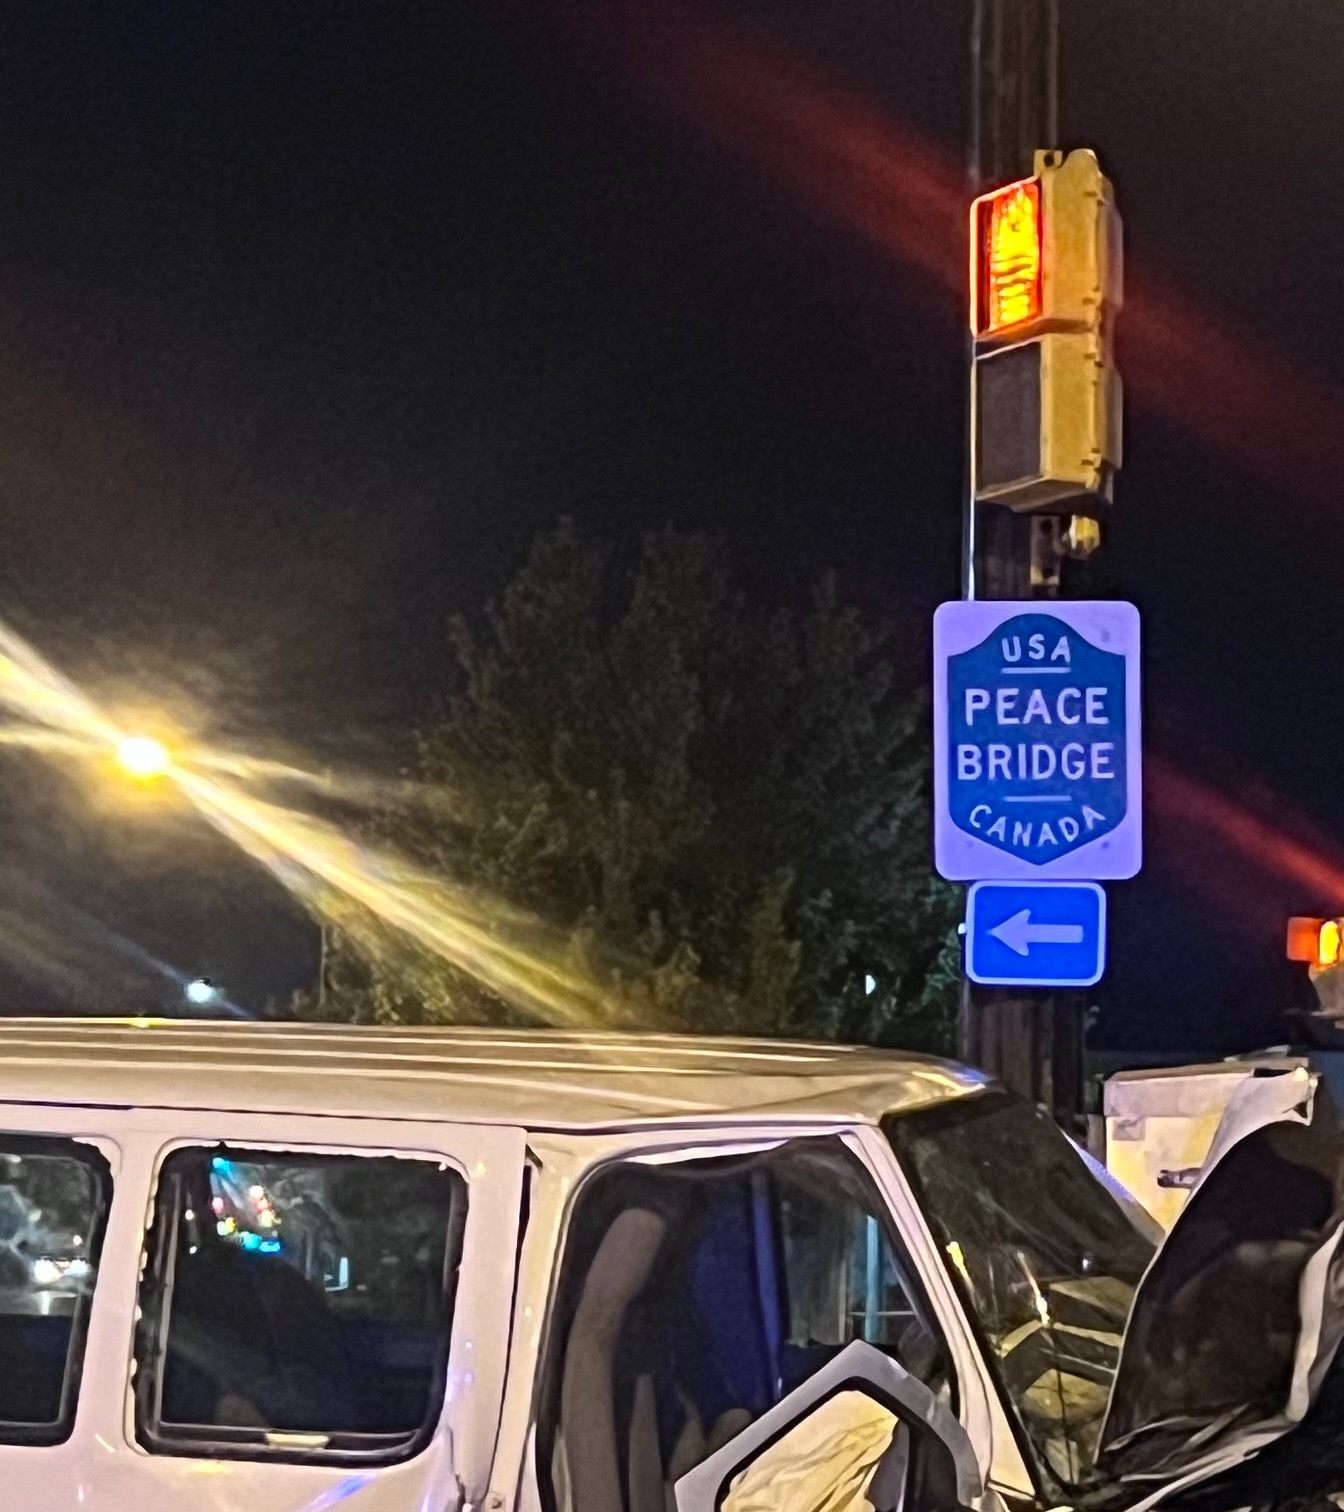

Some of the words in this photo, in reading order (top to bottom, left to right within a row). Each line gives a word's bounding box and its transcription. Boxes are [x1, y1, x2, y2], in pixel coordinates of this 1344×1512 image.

[1001, 633, 1071, 662] USA
[965, 687, 1109, 726] PEACE
[957, 743, 1114, 781] BRIDGE
[969, 804, 1106, 847] CANADA
